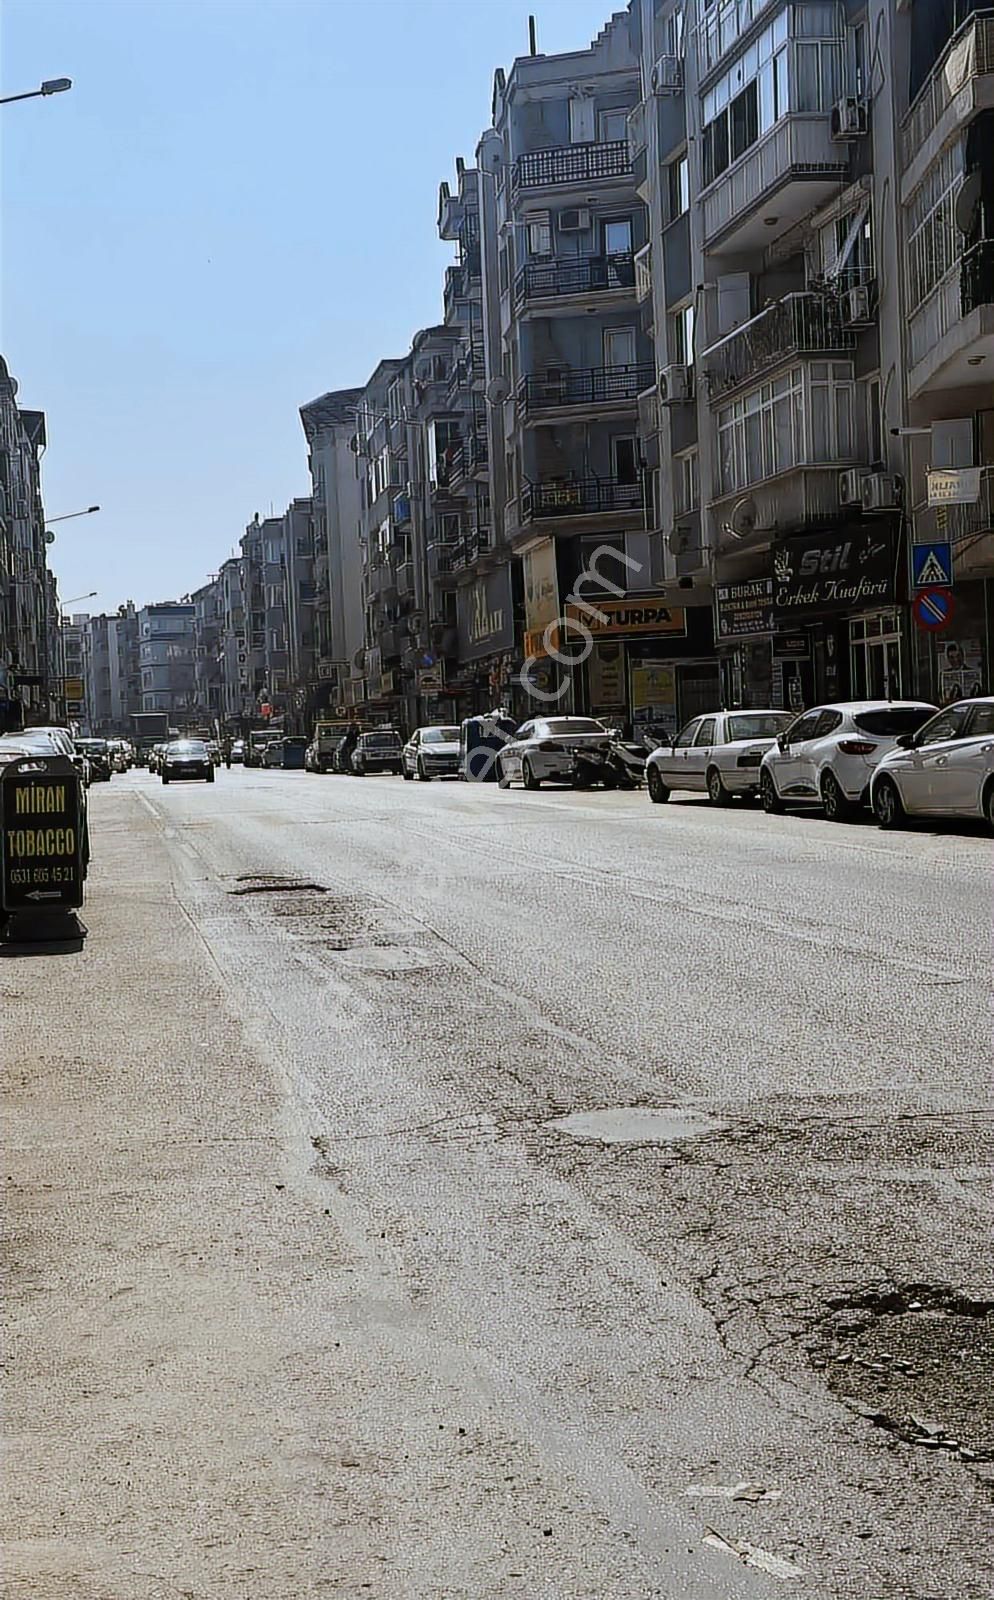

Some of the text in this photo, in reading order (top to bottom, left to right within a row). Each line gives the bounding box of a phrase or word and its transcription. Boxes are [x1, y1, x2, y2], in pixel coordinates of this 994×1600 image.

[800, 542, 852, 576] Stil
[731, 583, 763, 599] BURAK
[776, 582, 819, 607] Erkek
[821, 576, 888, 605] Kuaförü
[15, 781, 65, 814] MİRAN
[7, 828, 75, 857] TOBACCO
